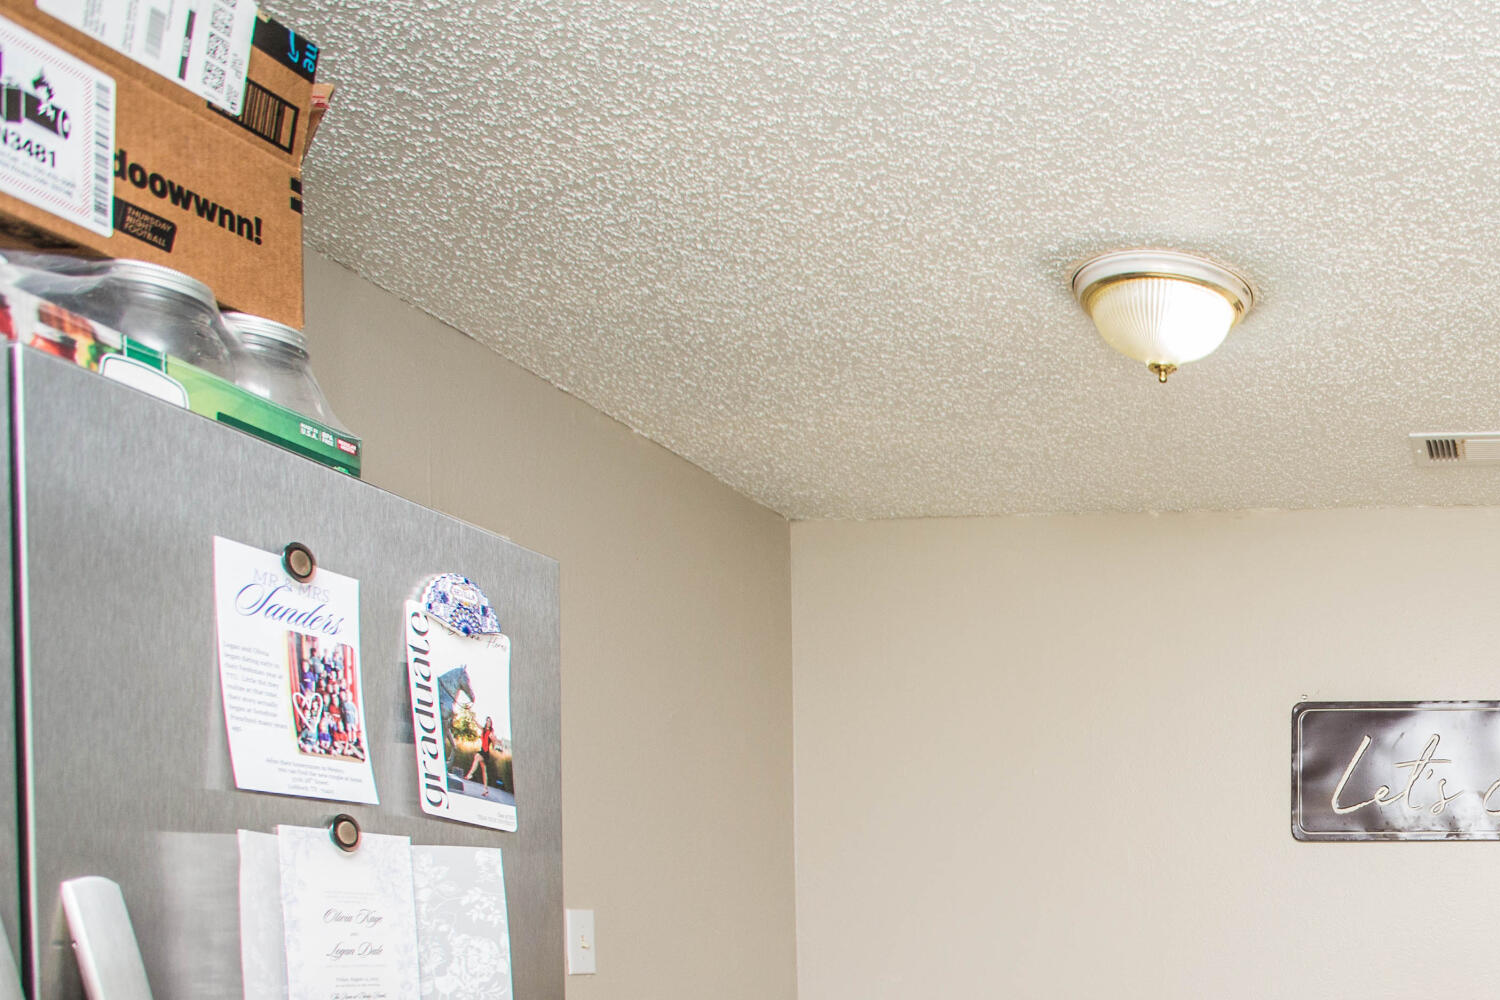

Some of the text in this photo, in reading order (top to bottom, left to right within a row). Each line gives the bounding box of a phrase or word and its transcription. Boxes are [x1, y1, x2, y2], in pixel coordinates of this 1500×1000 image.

[235, 583, 345, 636] Sanders
[408, 610, 450, 810] graduate
[1331, 734, 1464, 815] Let's
